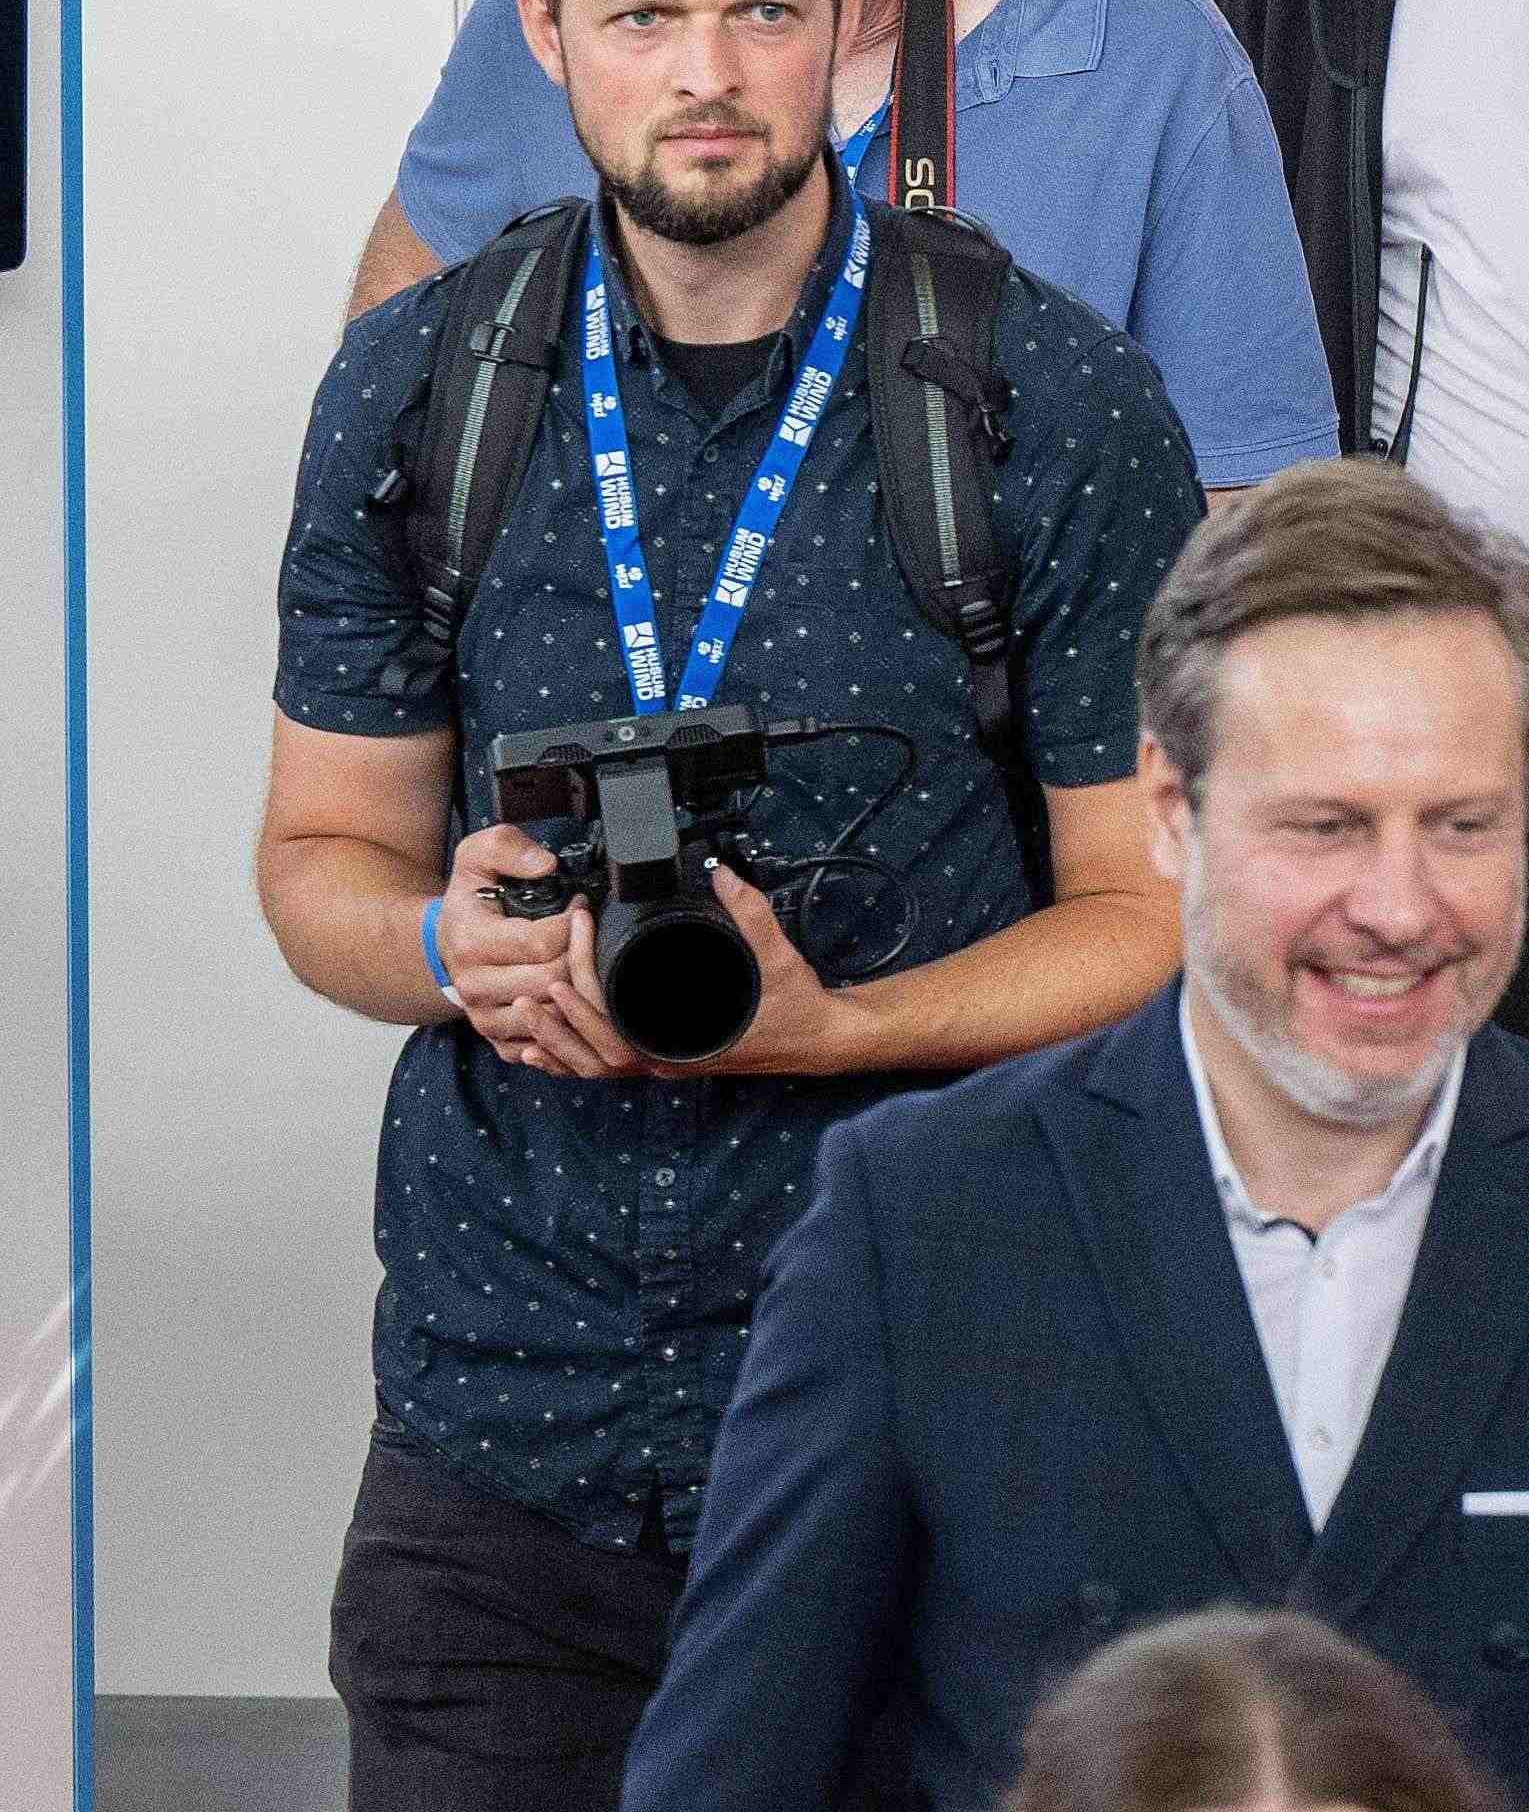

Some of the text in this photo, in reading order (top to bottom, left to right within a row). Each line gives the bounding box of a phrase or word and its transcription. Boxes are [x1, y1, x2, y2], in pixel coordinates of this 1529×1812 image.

[800, 371, 832, 421] WIND
[600, 477, 621, 530] WIND
[735, 532, 766, 582] WIND
[627, 649, 654, 701] WIND
